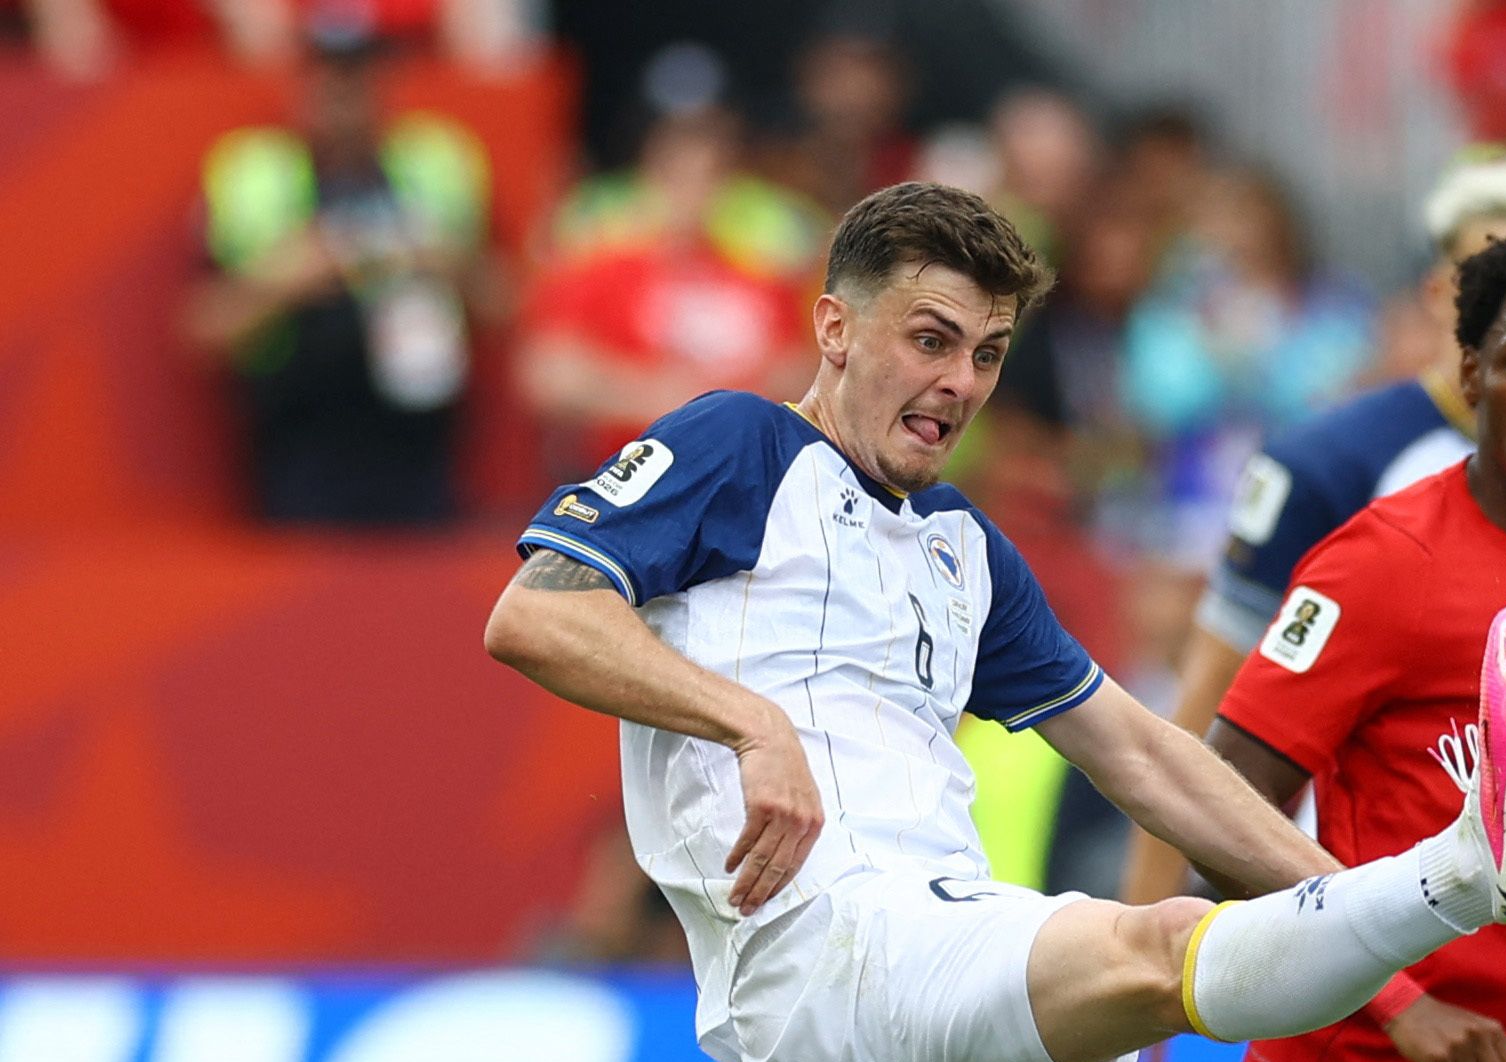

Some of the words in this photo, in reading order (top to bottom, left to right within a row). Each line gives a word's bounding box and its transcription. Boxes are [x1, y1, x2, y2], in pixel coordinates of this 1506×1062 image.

[596, 479, 619, 497] 026
[832, 512, 865, 529] KELME
[907, 591, 934, 690] 6
